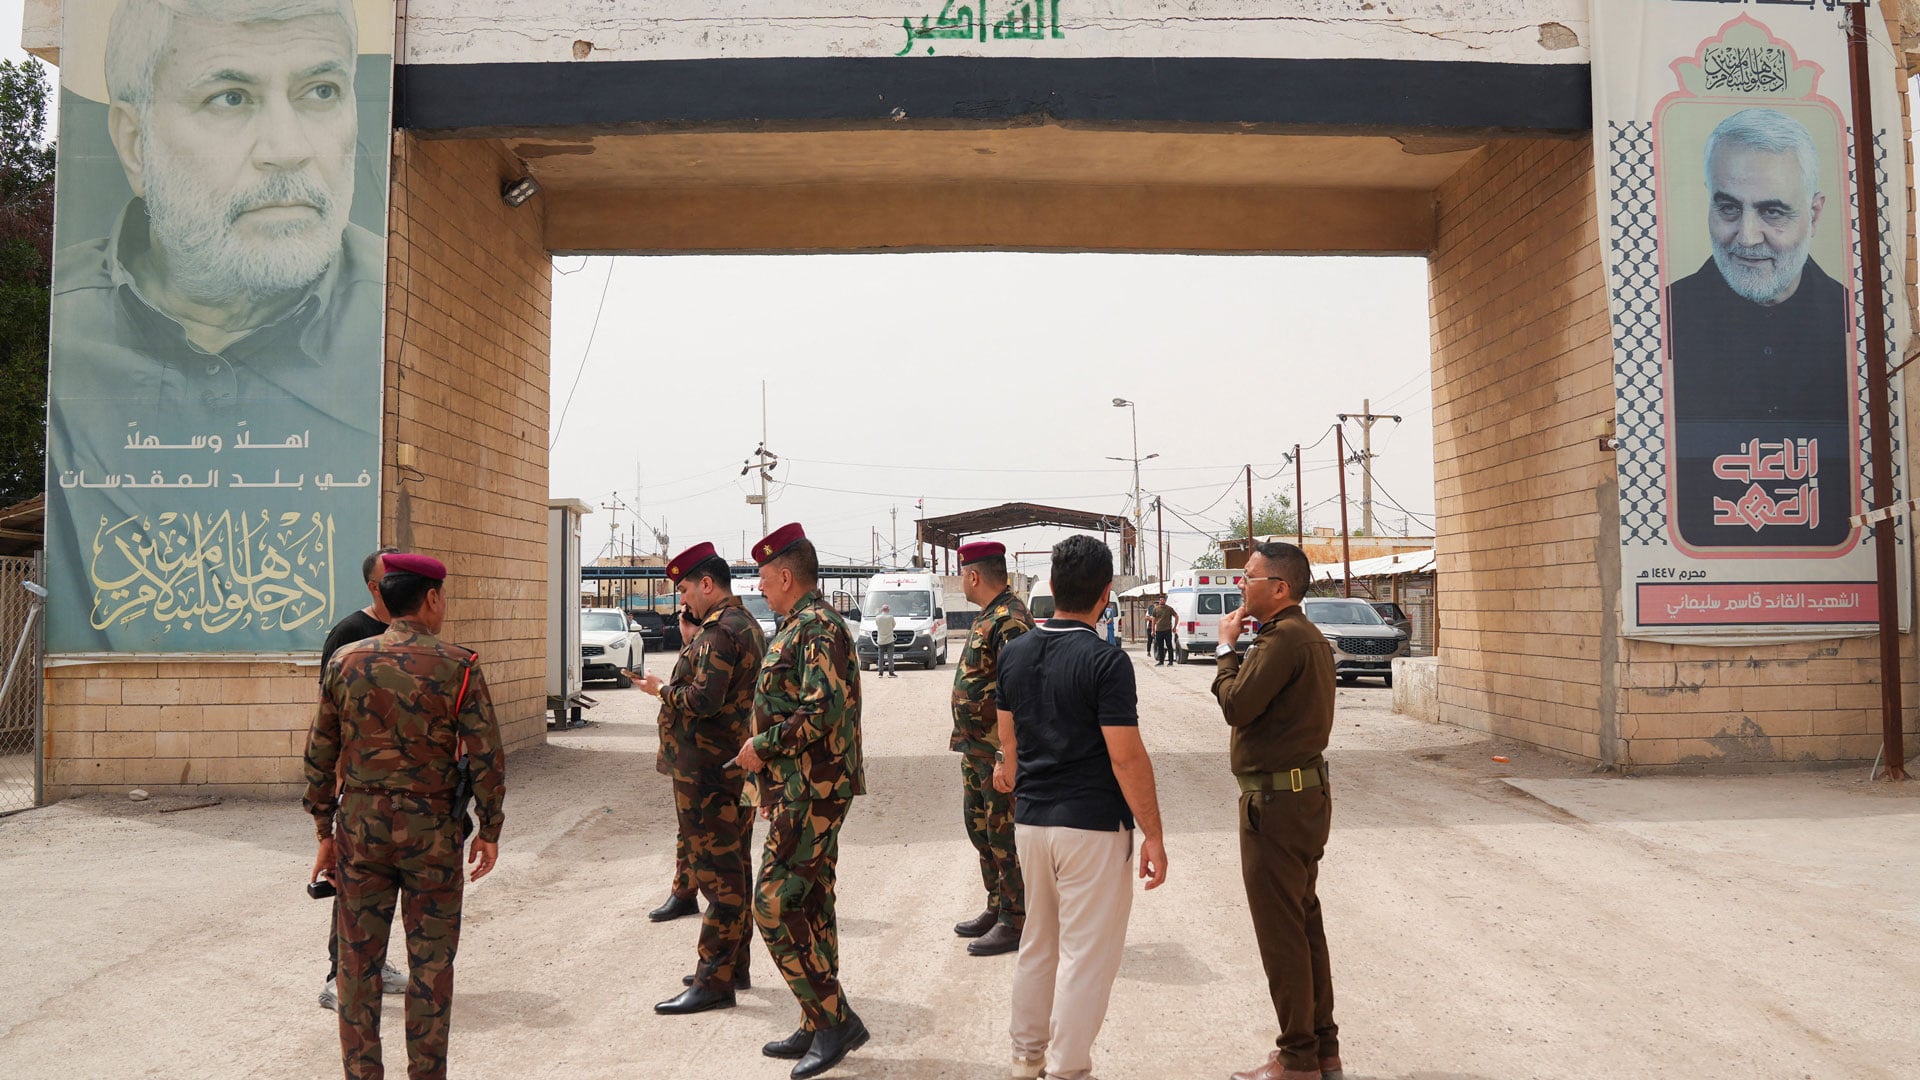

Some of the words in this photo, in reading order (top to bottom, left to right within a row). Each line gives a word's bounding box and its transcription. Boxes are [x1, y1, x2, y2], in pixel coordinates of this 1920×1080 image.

[993, 0, 1066, 40] الله
[58, 469, 219, 489] المقدسات
[229, 469, 304, 491] بلد
[314, 469, 371, 492] في
[1678, 569, 1707, 580] محرم
[1667, 593, 1720, 619] سليماني
[1724, 591, 1762, 610] قاسم
[1765, 592, 1805, 609] القائد
[1808, 592, 1859, 612] الشهيد
